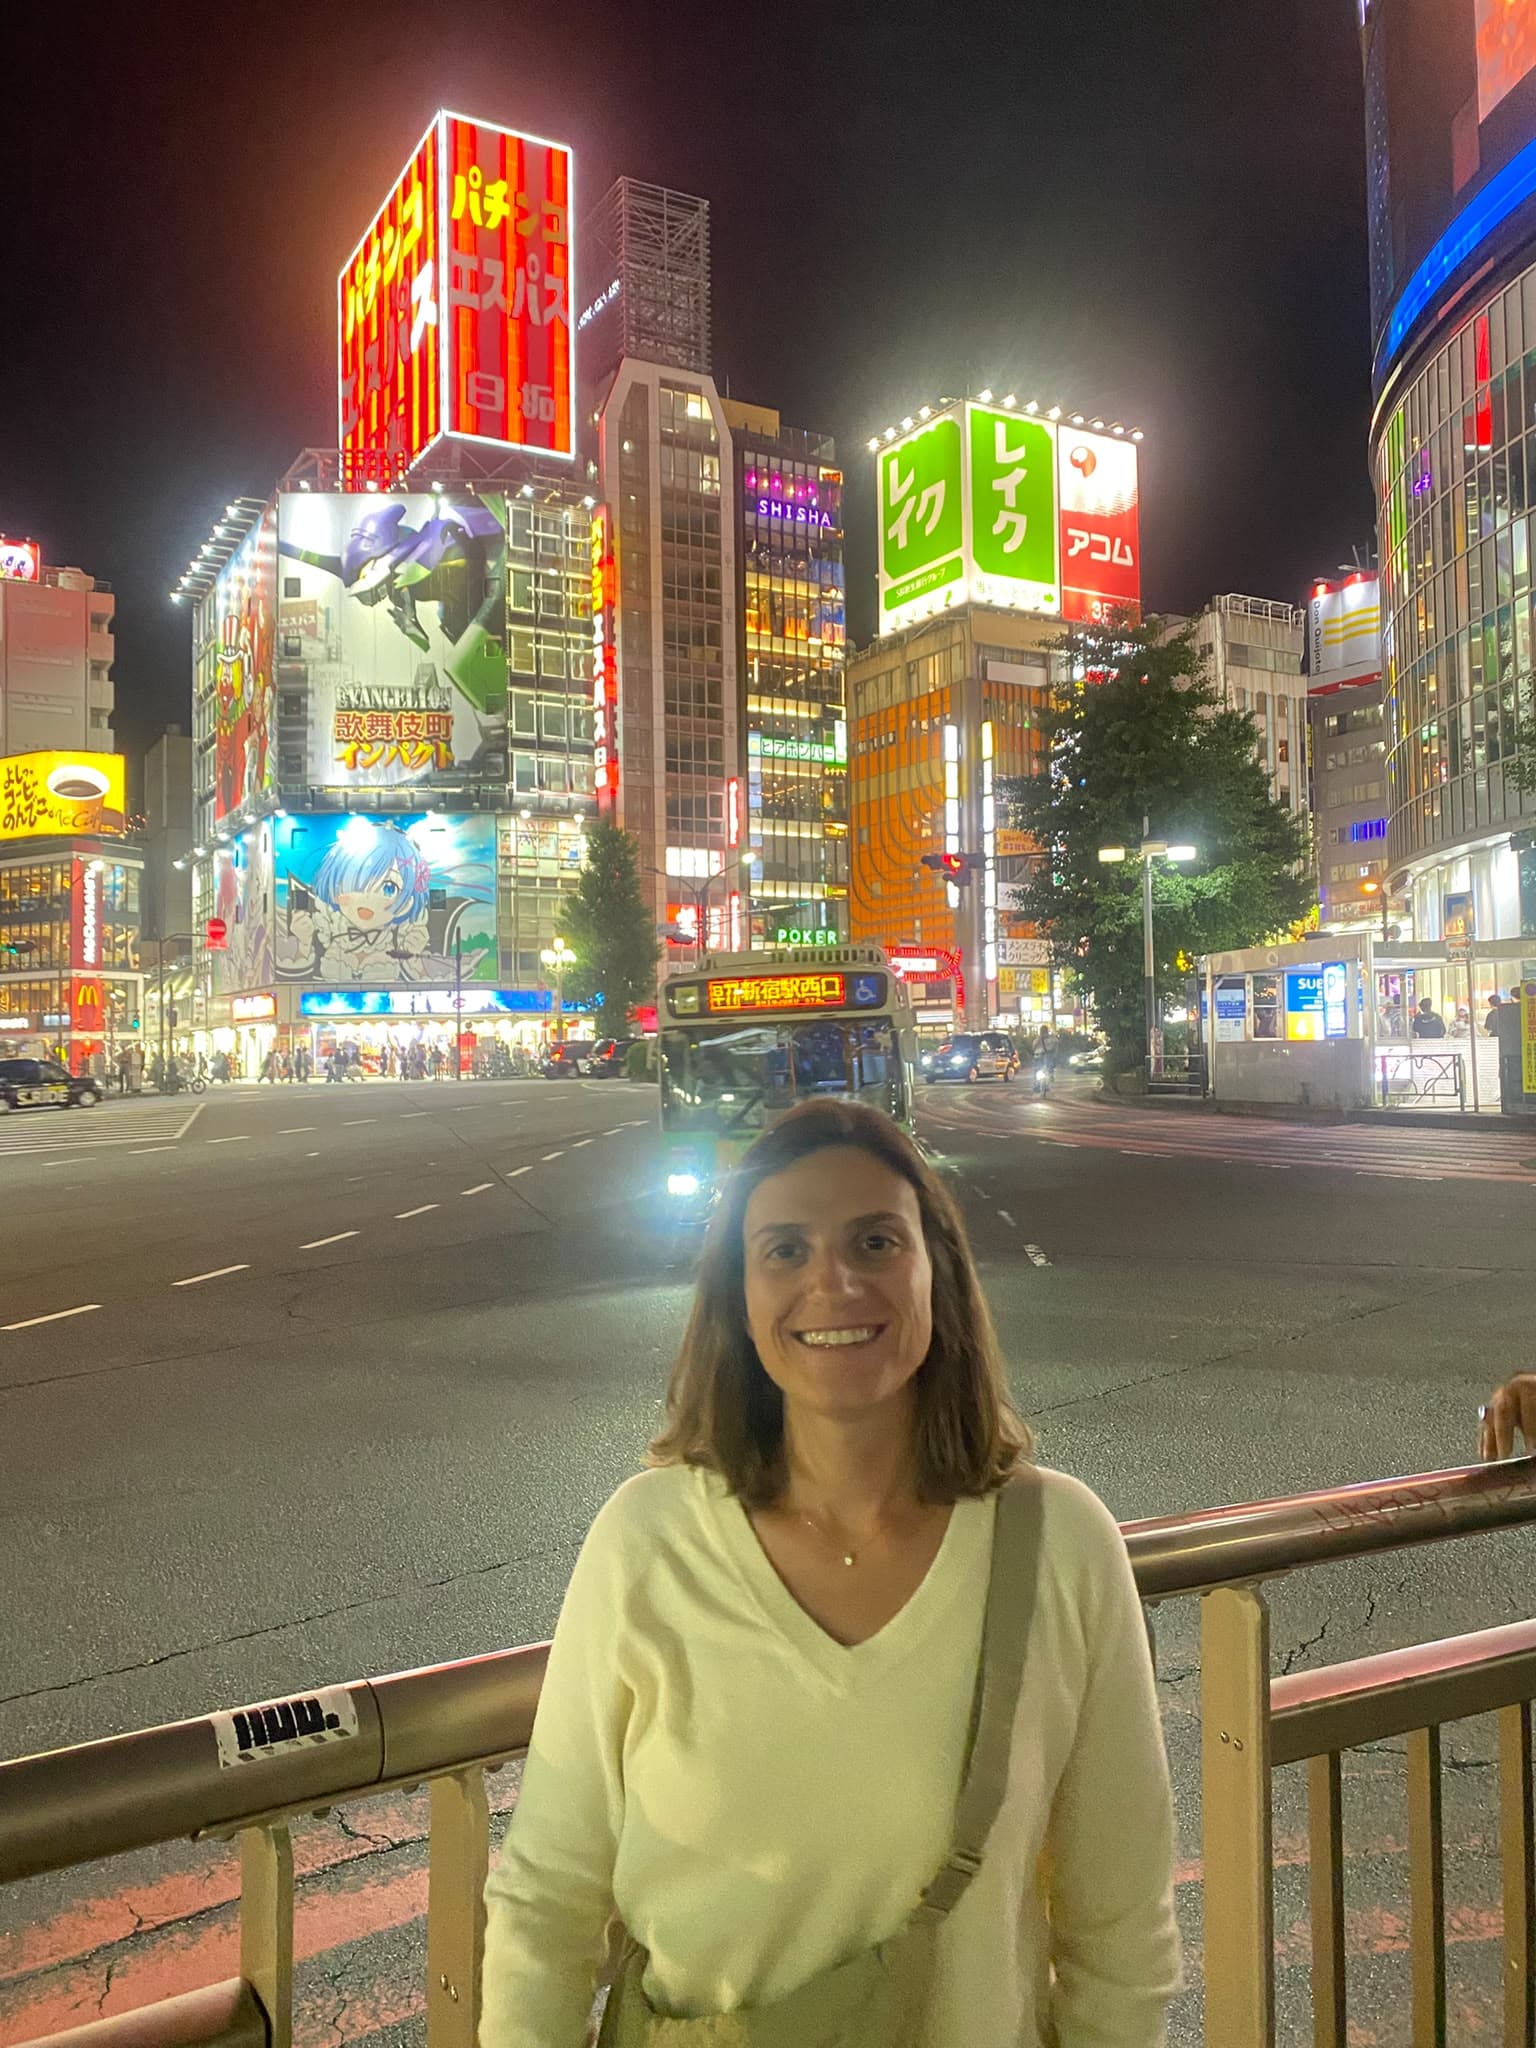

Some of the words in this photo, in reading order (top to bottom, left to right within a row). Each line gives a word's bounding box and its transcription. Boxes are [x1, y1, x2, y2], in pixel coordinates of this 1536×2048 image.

[451, 165, 567, 245] パチンコ
[450, 249, 571, 327] エスパス
[991, 421, 1028, 555] レイク
[759, 499, 832, 528] SHISHA
[888, 457, 946, 550] レイク
[1067, 527, 1135, 567] アコム
[1313, 601, 1321, 624] Don
[1313, 627, 1323, 673] Quijote
[336, 686, 452, 710] EVANGELION
[335, 712, 454, 740] 歌舞伎町
[335, 740, 455, 770] インパクト
[778, 929, 837, 945] POKER
[741, 977, 840, 1001] 新宿駅西口
